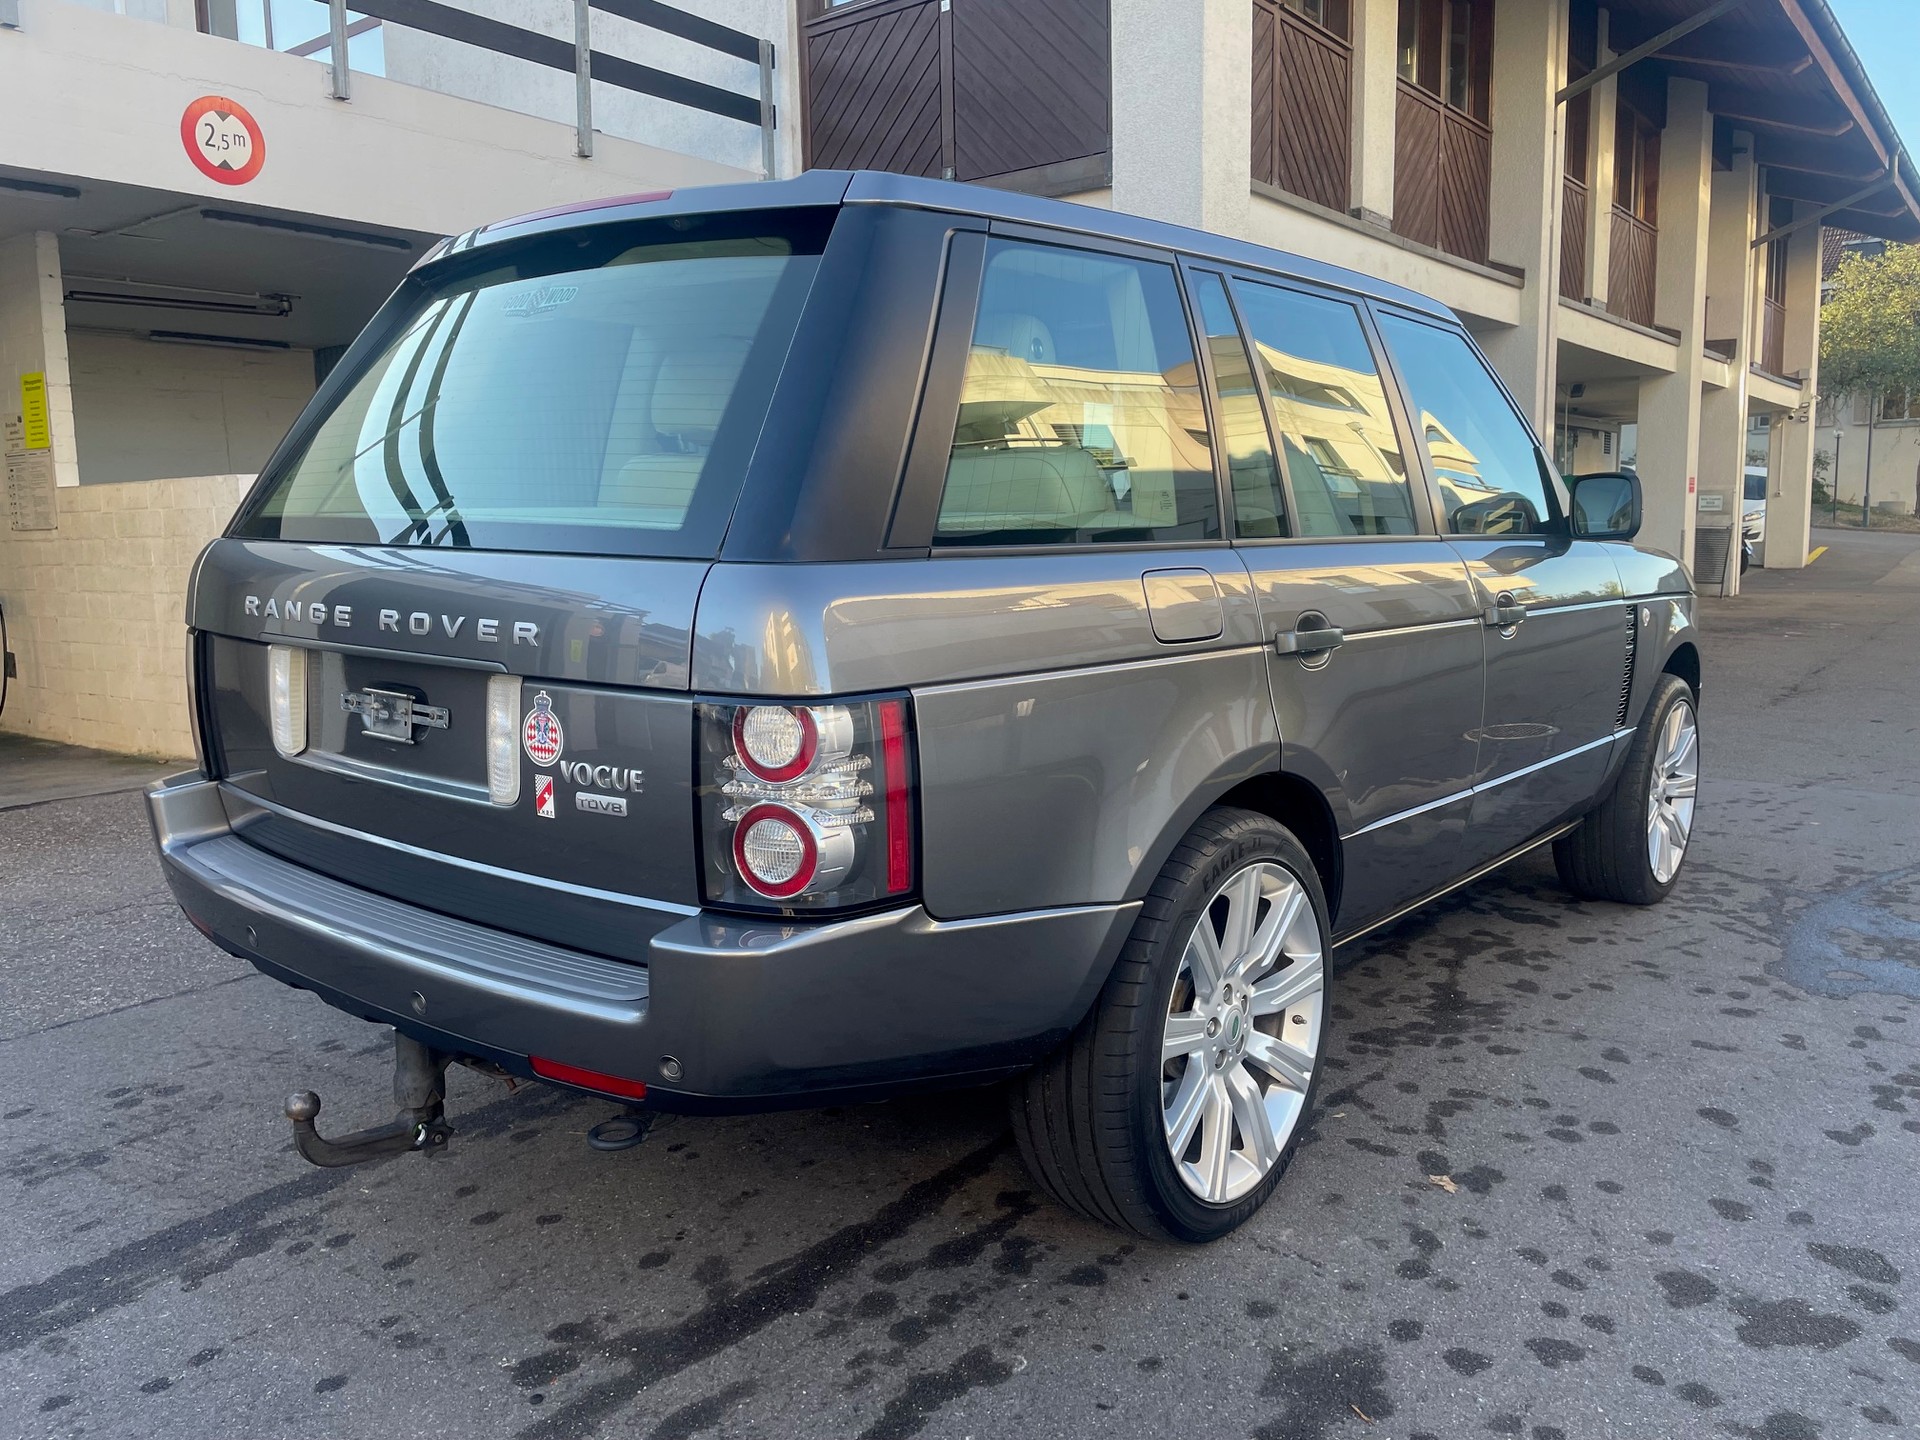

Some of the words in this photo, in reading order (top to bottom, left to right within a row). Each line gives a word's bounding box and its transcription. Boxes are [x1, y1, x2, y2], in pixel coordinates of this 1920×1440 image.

[545, 287, 577, 305] WOOD
[244, 595, 351, 627] RANGE
[378, 608, 540, 647] ROVER
[560, 760, 645, 794] VOGUE
[577, 798, 625, 814] TDV8
[1202, 841, 1246, 893] EAGLE
